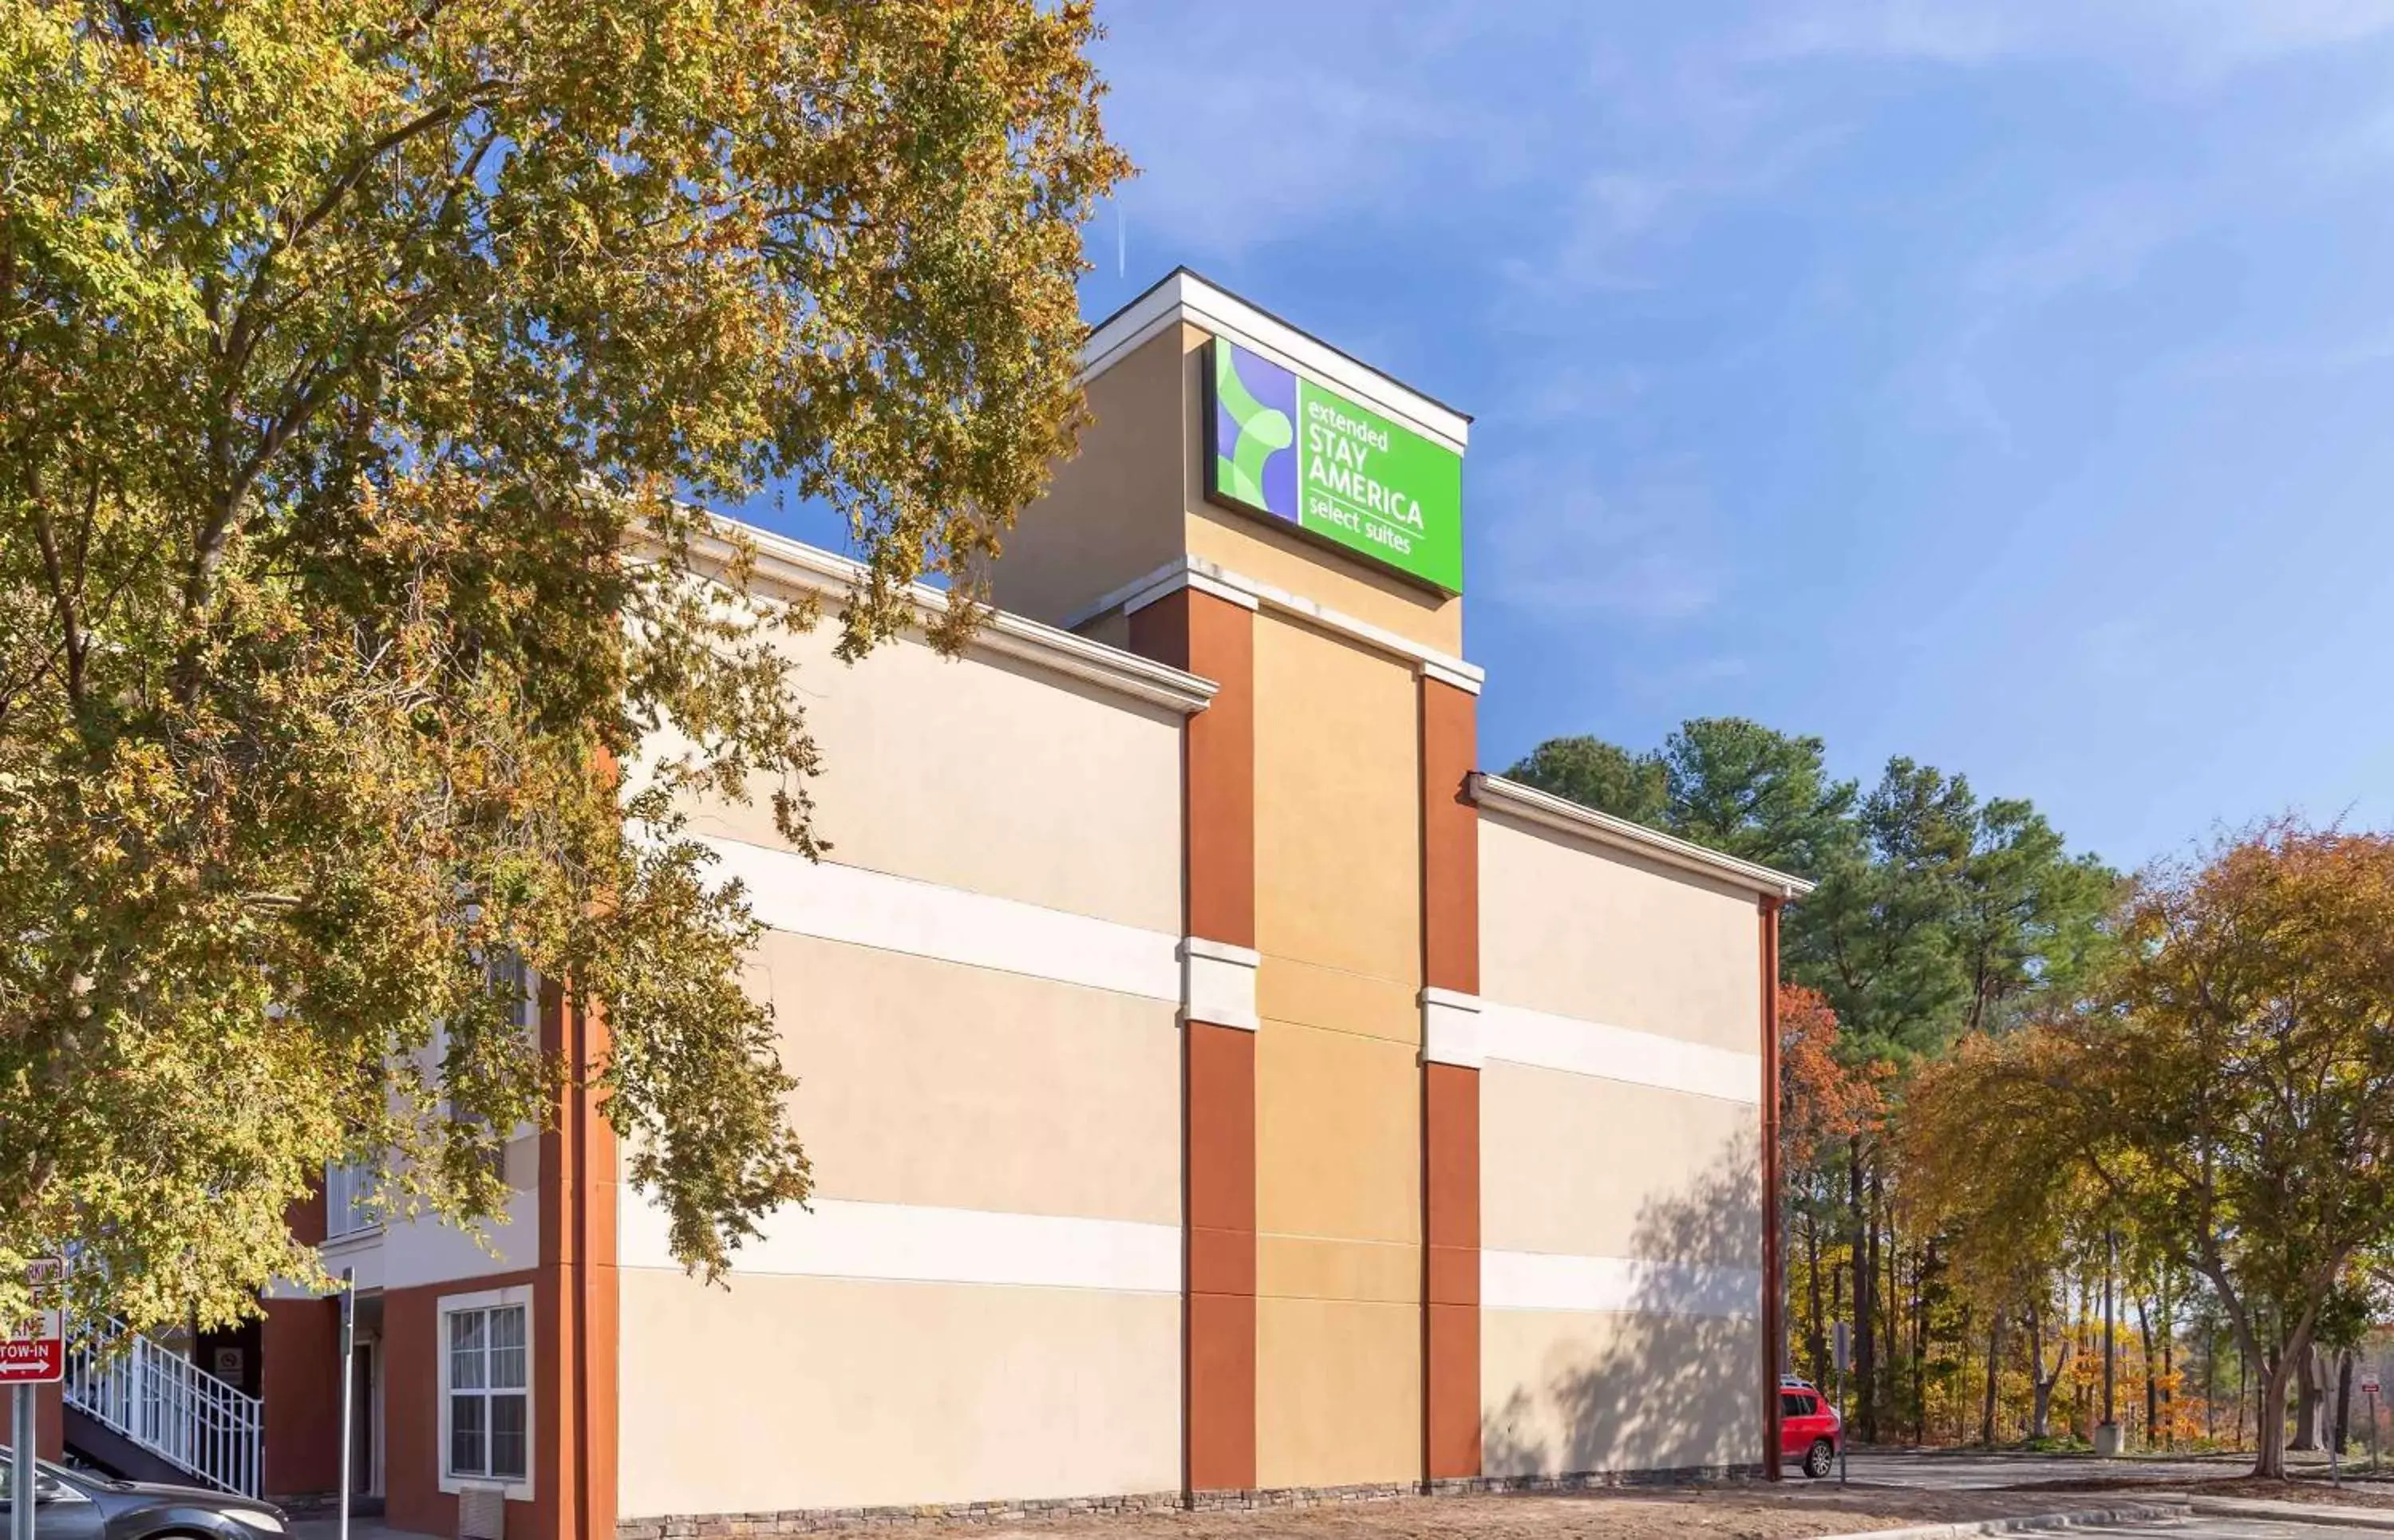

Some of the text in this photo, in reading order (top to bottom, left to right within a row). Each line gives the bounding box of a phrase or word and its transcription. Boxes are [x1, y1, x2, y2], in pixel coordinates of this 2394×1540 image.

[1308, 401, 1389, 452] extended
[1309, 423, 1368, 472] STAY
[1309, 455, 1424, 531] AMERICA
[1310, 496, 1412, 555] select suites
[0, 1345, 49, 1358] TOW-IN
